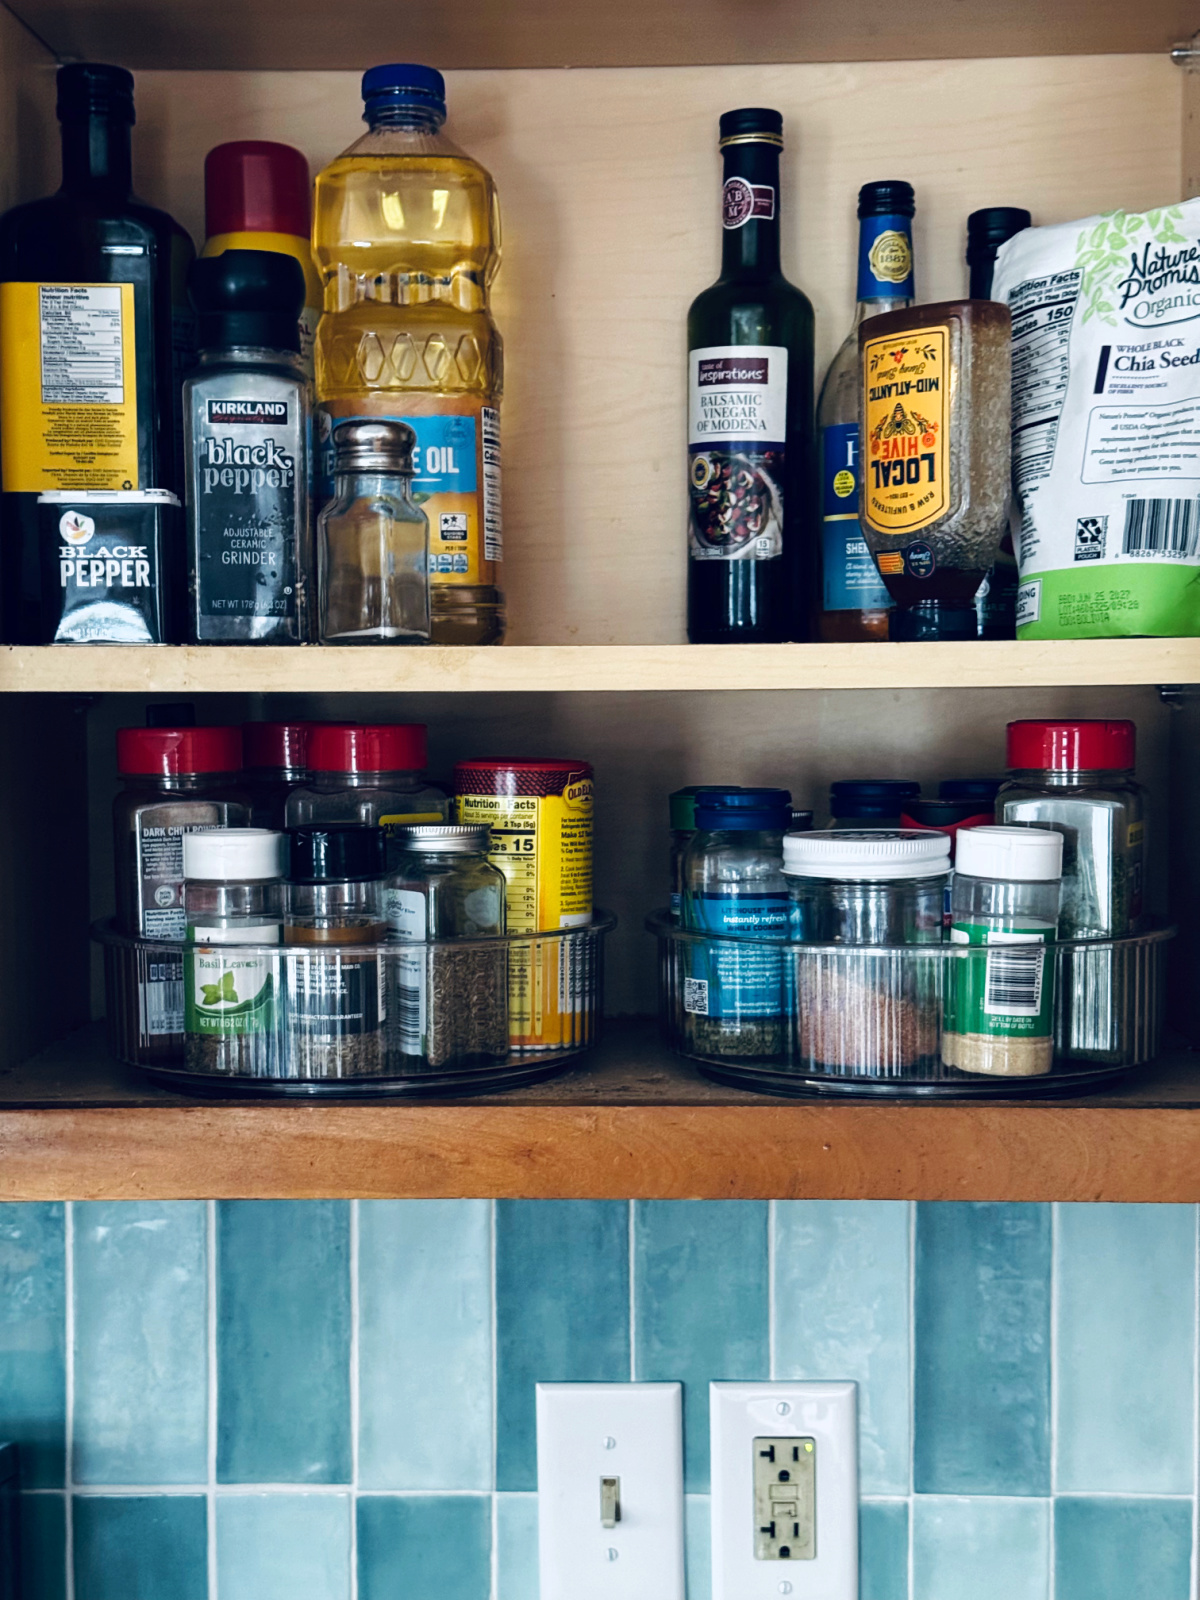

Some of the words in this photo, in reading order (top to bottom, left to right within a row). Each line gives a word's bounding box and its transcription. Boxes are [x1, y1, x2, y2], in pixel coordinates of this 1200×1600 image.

[1128, 239, 1200, 279] Nature'
[1050, 271, 1080, 285] Facts
[1117, 263, 1200, 310] Promis
[1011, 319, 1038, 338] alories
[1047, 305, 1073, 321] 150
[1116, 344, 1151, 353] WHOLE
[1152, 338, 1185, 351] BLACK
[715, 360, 724, 369] of
[898, 361, 926, 375] Honey
[1114, 355, 1156, 372] Chia
[700, 367, 763, 383] inspirations
[869, 376, 940, 402] MID-ATLANTIC
[700, 393, 762, 408] BALSAMIC
[211, 402, 286, 416] KIRKLAND
[703, 406, 758, 419] VINEGAR
[697, 420, 711, 433] OF
[710, 418, 767, 431] MODENA
[205, 437, 293, 470] black
[881, 434, 919, 460] HIVE
[426, 446, 460, 474] OIL
[870, 452, 937, 489] LOCAL
[203, 465, 294, 495] pepper
[871, 497, 908, 515] UNFILTERED
[916, 490, 935, 509] RAW
[908, 503, 916, 512] &
[223, 528, 274, 538] ADJUSTABLE
[230, 539, 267, 549] CERAMIC
[760, 540, 767, 548] 15
[58, 546, 148, 559] BLACK
[221, 551, 276, 566] GRINDER
[1129, 550, 1158, 558] 88267
[60, 559, 151, 587] PEPPER
[212, 599, 226, 609] NET
[227, 599, 239, 609] WT
[274, 599, 287, 610] OZ)
[568, 786, 581, 801] OLD
[464, 797, 501, 809] Nutrition
[507, 799, 536, 810] Facts
[480, 812, 500, 820] servings
[143, 827, 166, 837] DARK
[510, 821, 522, 829] Tsp
[523, 821, 536, 829] (5g)
[561, 831, 578, 839] Make
[512, 838, 534, 852] 15
[761, 913, 787, 925] refresh
[198, 958, 221, 969] Basil
[222, 959, 259, 969] Leaves
